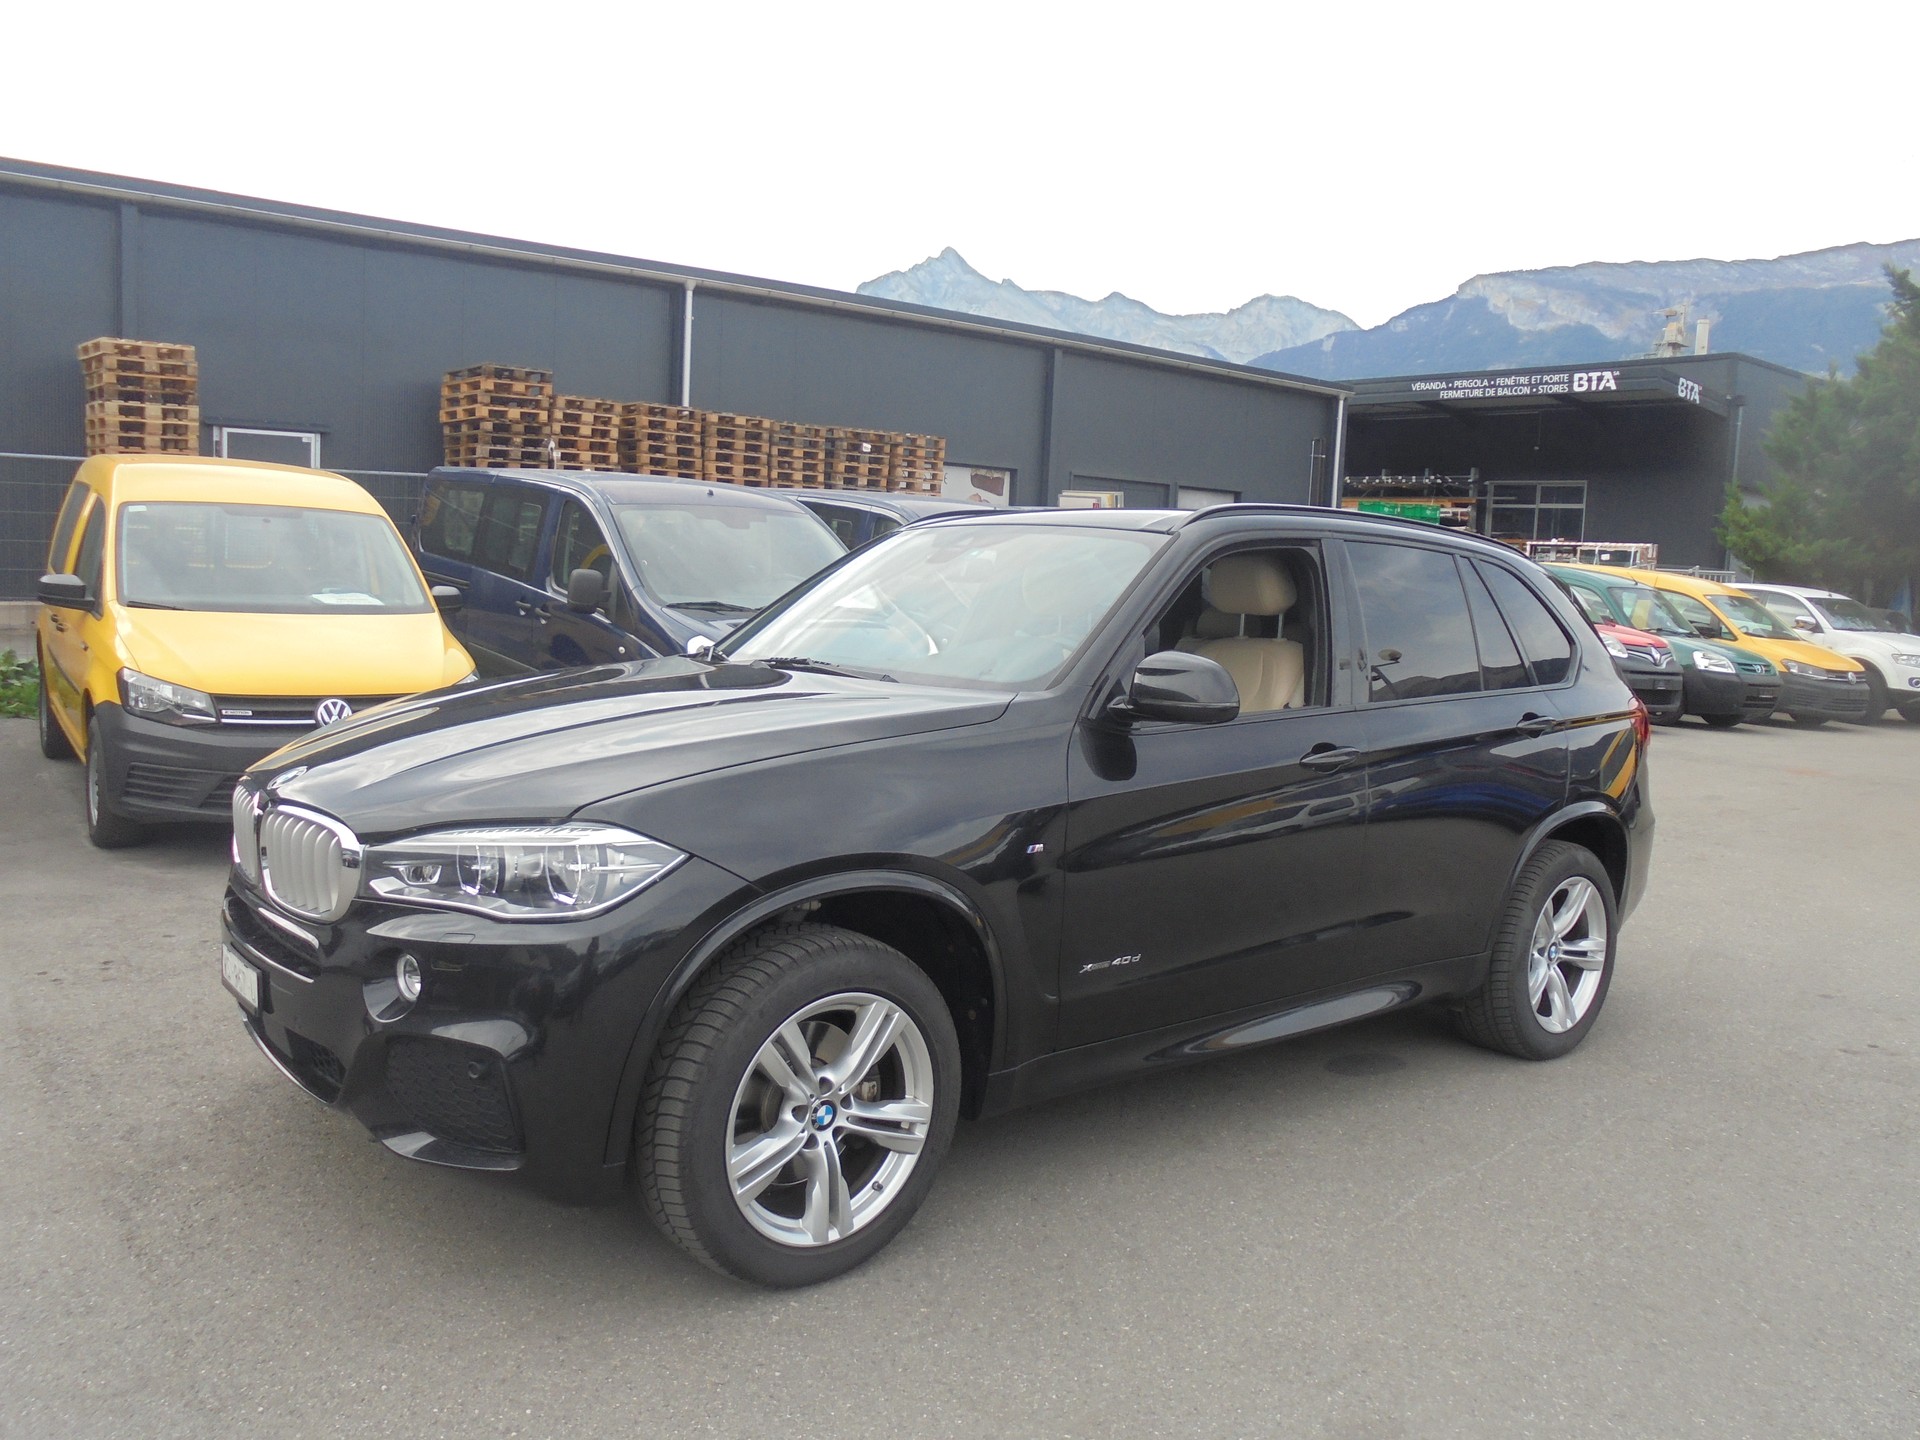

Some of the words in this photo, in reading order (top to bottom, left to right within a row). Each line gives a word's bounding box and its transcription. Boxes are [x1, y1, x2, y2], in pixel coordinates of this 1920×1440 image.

[1412, 382, 1447, 391] VÉRANDA
[1454, 379, 1489, 388] PERGOLA
[1496, 376, 1530, 386] FENÊTRE
[1532, 375, 1541, 384] ET
[1543, 374, 1569, 383] PORTE
[1573, 371, 1617, 392] BTA
[1678, 377, 1700, 404] BTA
[1440, 388, 1484, 399] FERMETURE
[1486, 388, 1496, 396] DE
[1497, 386, 1530, 396] BALCON
[1538, 384, 1569, 394] STORES
